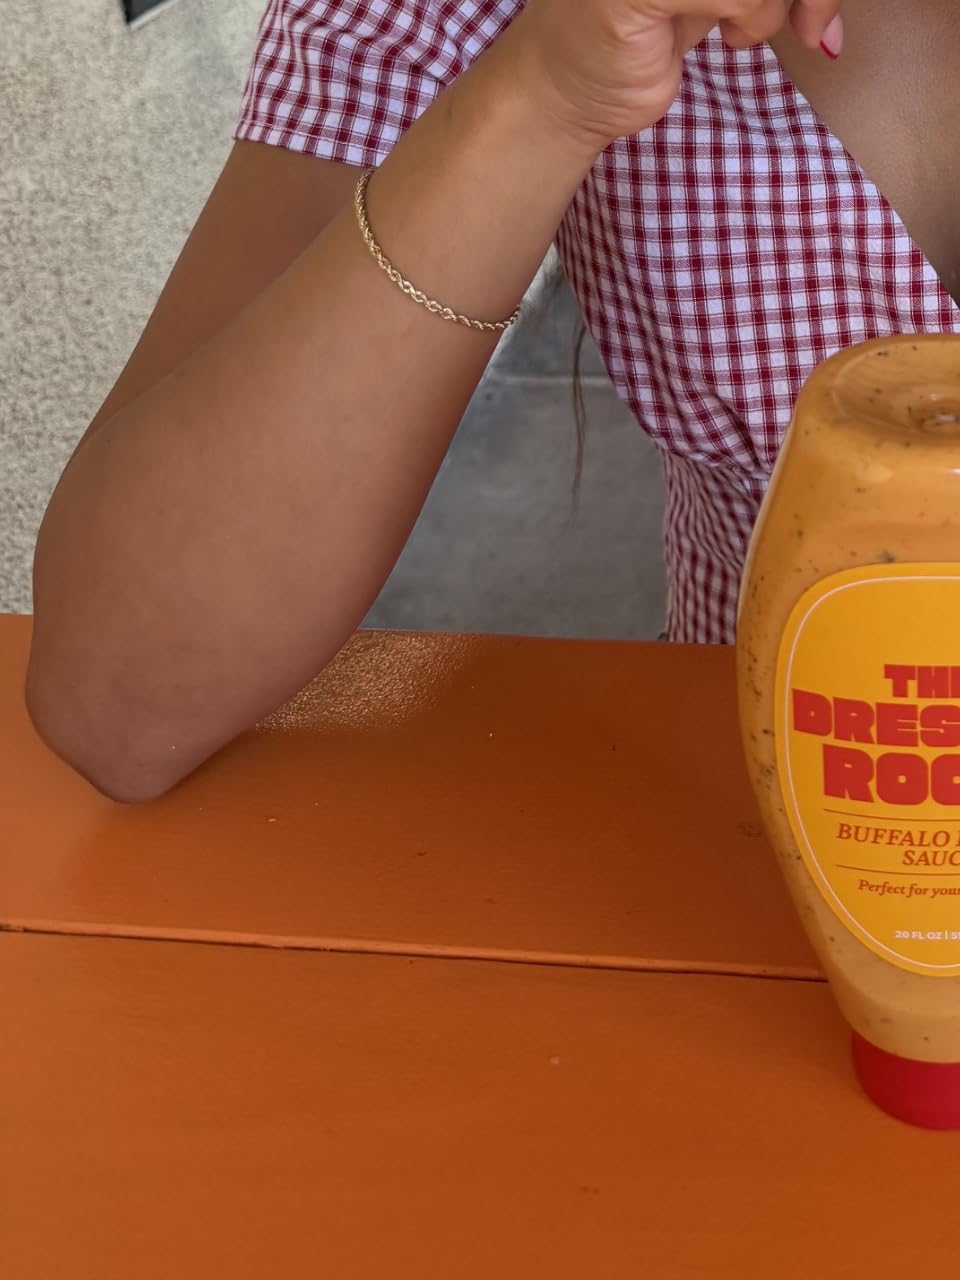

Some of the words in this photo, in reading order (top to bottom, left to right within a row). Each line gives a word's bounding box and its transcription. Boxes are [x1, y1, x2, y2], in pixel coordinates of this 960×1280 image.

[836, 823, 951, 847] BUFFALO
[858, 878, 906, 896] Perfect
[906, 883, 929, 898] for
[895, 930, 909, 939] 20
[911, 930, 924, 939] FL
[927, 931, 942, 940] OZ
